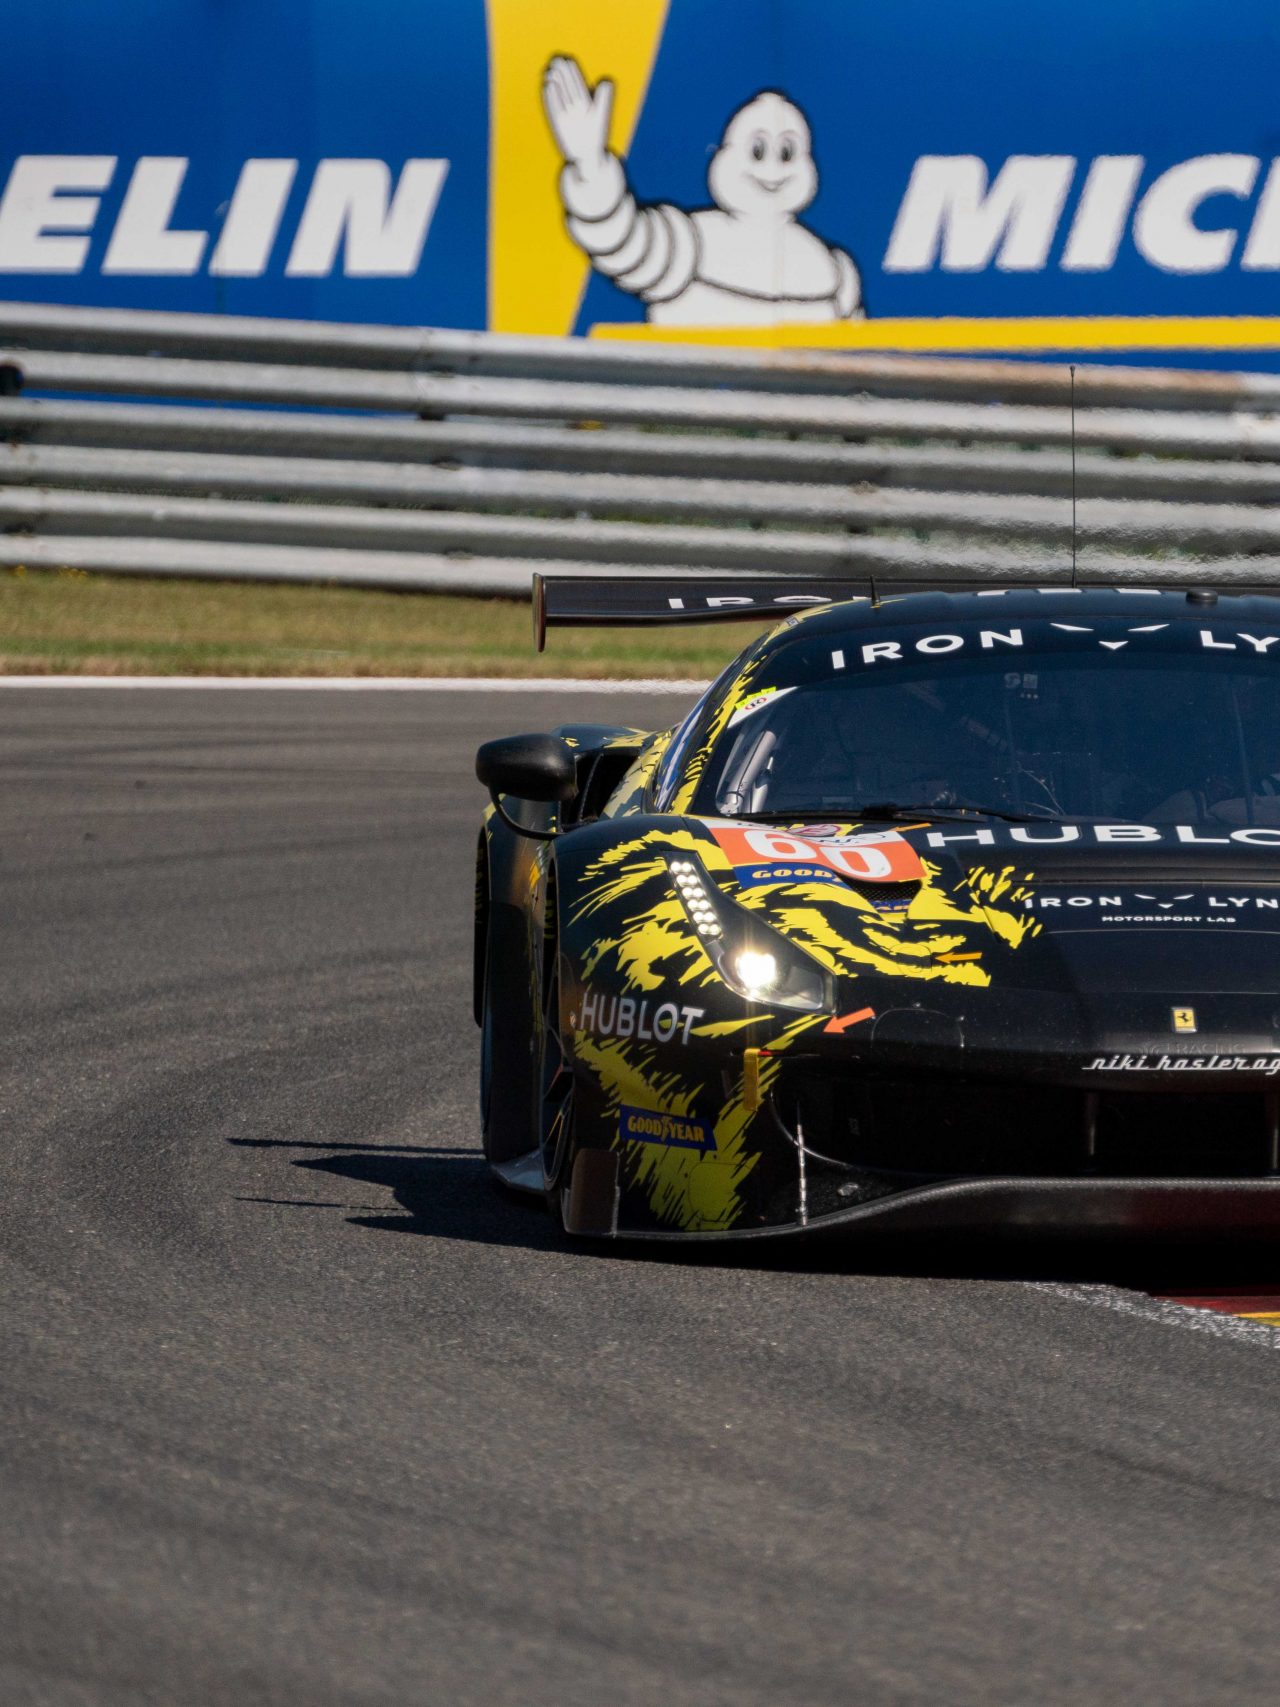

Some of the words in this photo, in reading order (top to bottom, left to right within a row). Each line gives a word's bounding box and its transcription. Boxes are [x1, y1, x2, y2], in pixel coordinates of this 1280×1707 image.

[831, 628, 1023, 669] IRON
[743, 829, 892, 879] 60
[752, 868, 842, 882] GOOD
[1024, 896, 1122, 909] IRON
[580, 992, 705, 1045] HUBLOT
[627, 1115, 705, 1142] GOODYEAR
